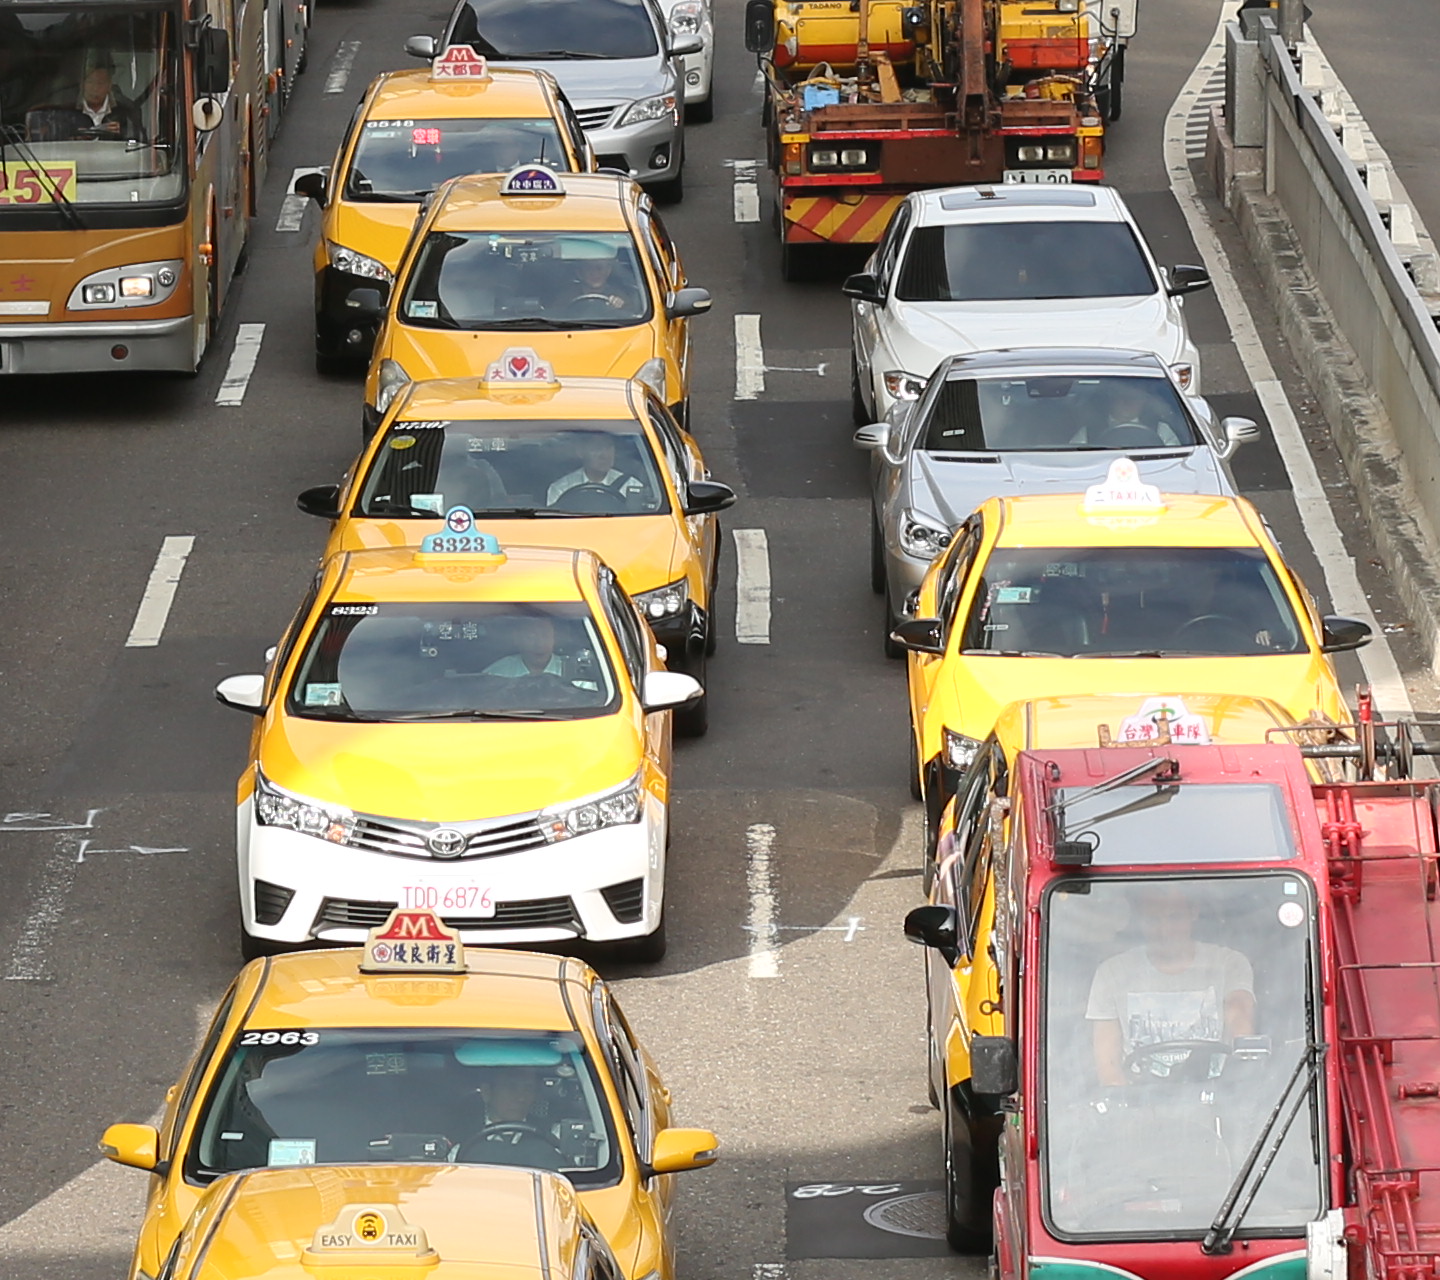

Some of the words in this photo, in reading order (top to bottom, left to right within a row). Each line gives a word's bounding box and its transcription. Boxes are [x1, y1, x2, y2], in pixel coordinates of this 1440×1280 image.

[454, 49, 468, 60] M
[437, 64, 484, 78] 大都會
[1110, 490, 1138, 502] TAXI
[432, 537, 487, 553] 8323
[399, 886, 488, 909] TDD-6876
[400, 916, 431, 938] M
[393, 943, 454, 964] 優良衛星
[240, 1032, 319, 1045] 2963
[321, 1234, 353, 1248] EASY
[388, 1233, 429, 1247] TAXI
